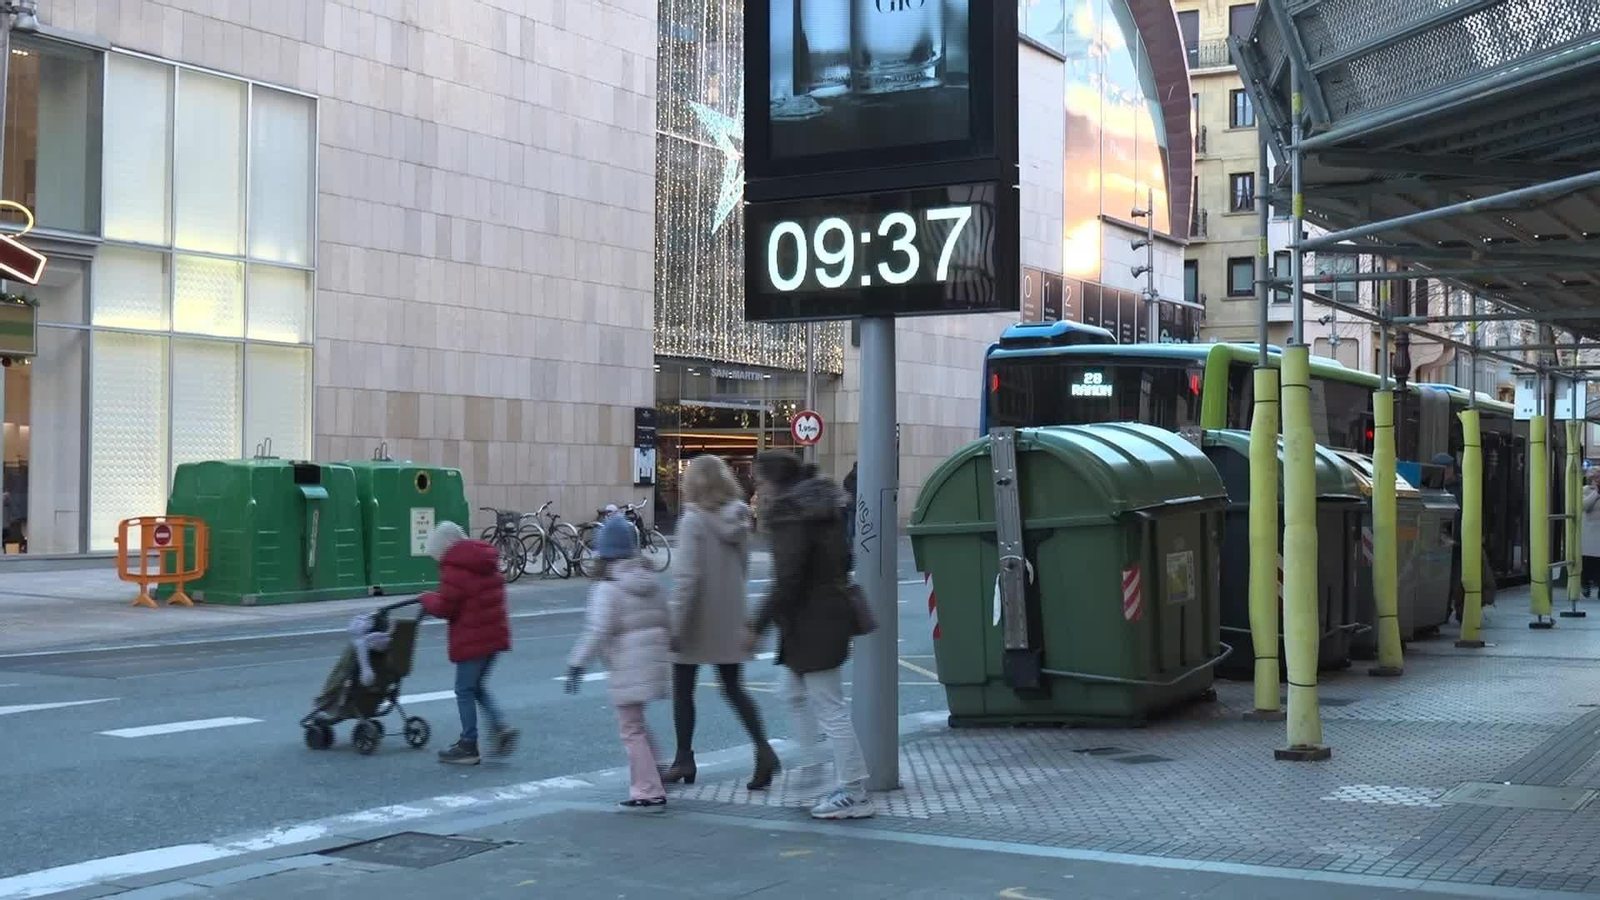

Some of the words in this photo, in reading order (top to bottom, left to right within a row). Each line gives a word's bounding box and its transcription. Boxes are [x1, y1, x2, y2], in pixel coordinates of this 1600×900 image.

[768, 206, 972, 291] 09:37
[1045, 281, 1050, 303] 1
[1065, 285, 1072, 307] 2
[711, 368, 729, 378] SAN
[732, 370, 763, 380] MARTIN
